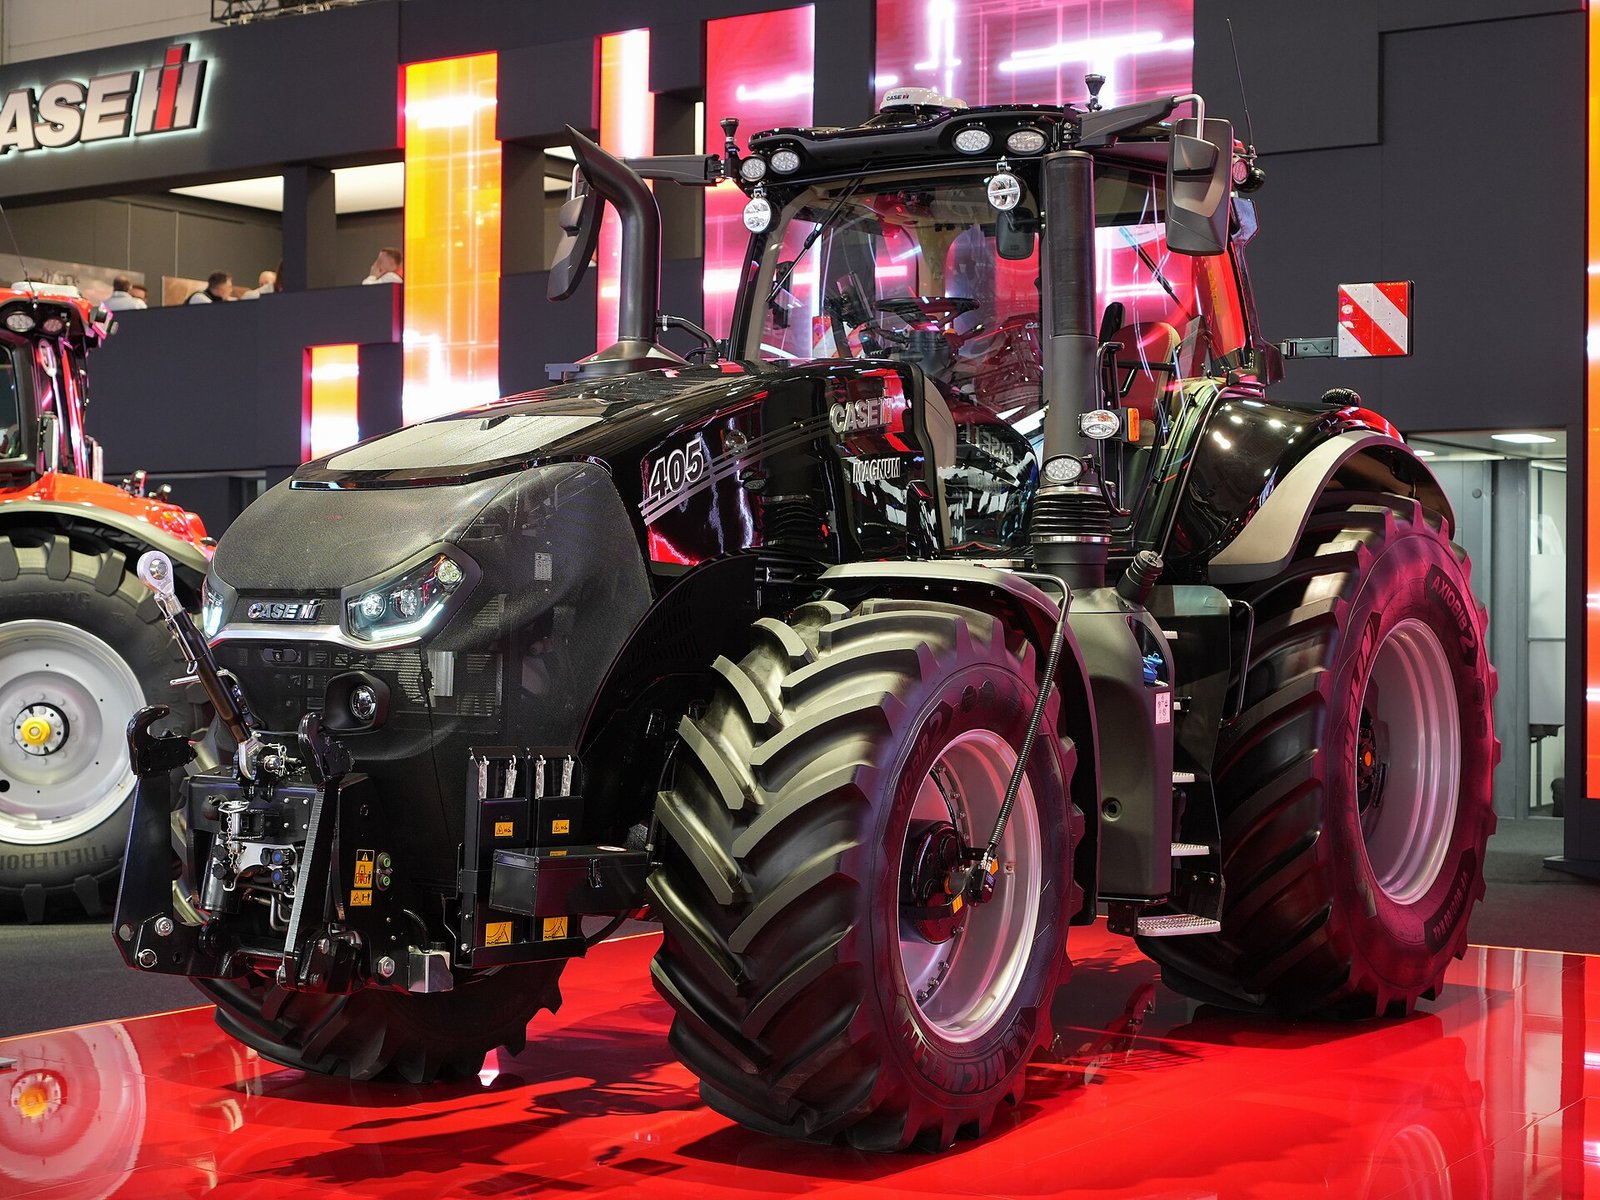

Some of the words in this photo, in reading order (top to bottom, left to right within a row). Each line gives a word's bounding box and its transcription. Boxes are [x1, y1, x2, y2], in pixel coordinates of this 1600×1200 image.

[829, 398, 879, 434] CASE
[649, 437, 704, 501] 405
[852, 457, 901, 483] MAGNUM
[248, 602, 299, 620] CASE
[1431, 575, 1468, 632] AXIOBIB
[1460, 626, 1475, 654] 2
[898, 1018, 1006, 1093] MICHELIN
